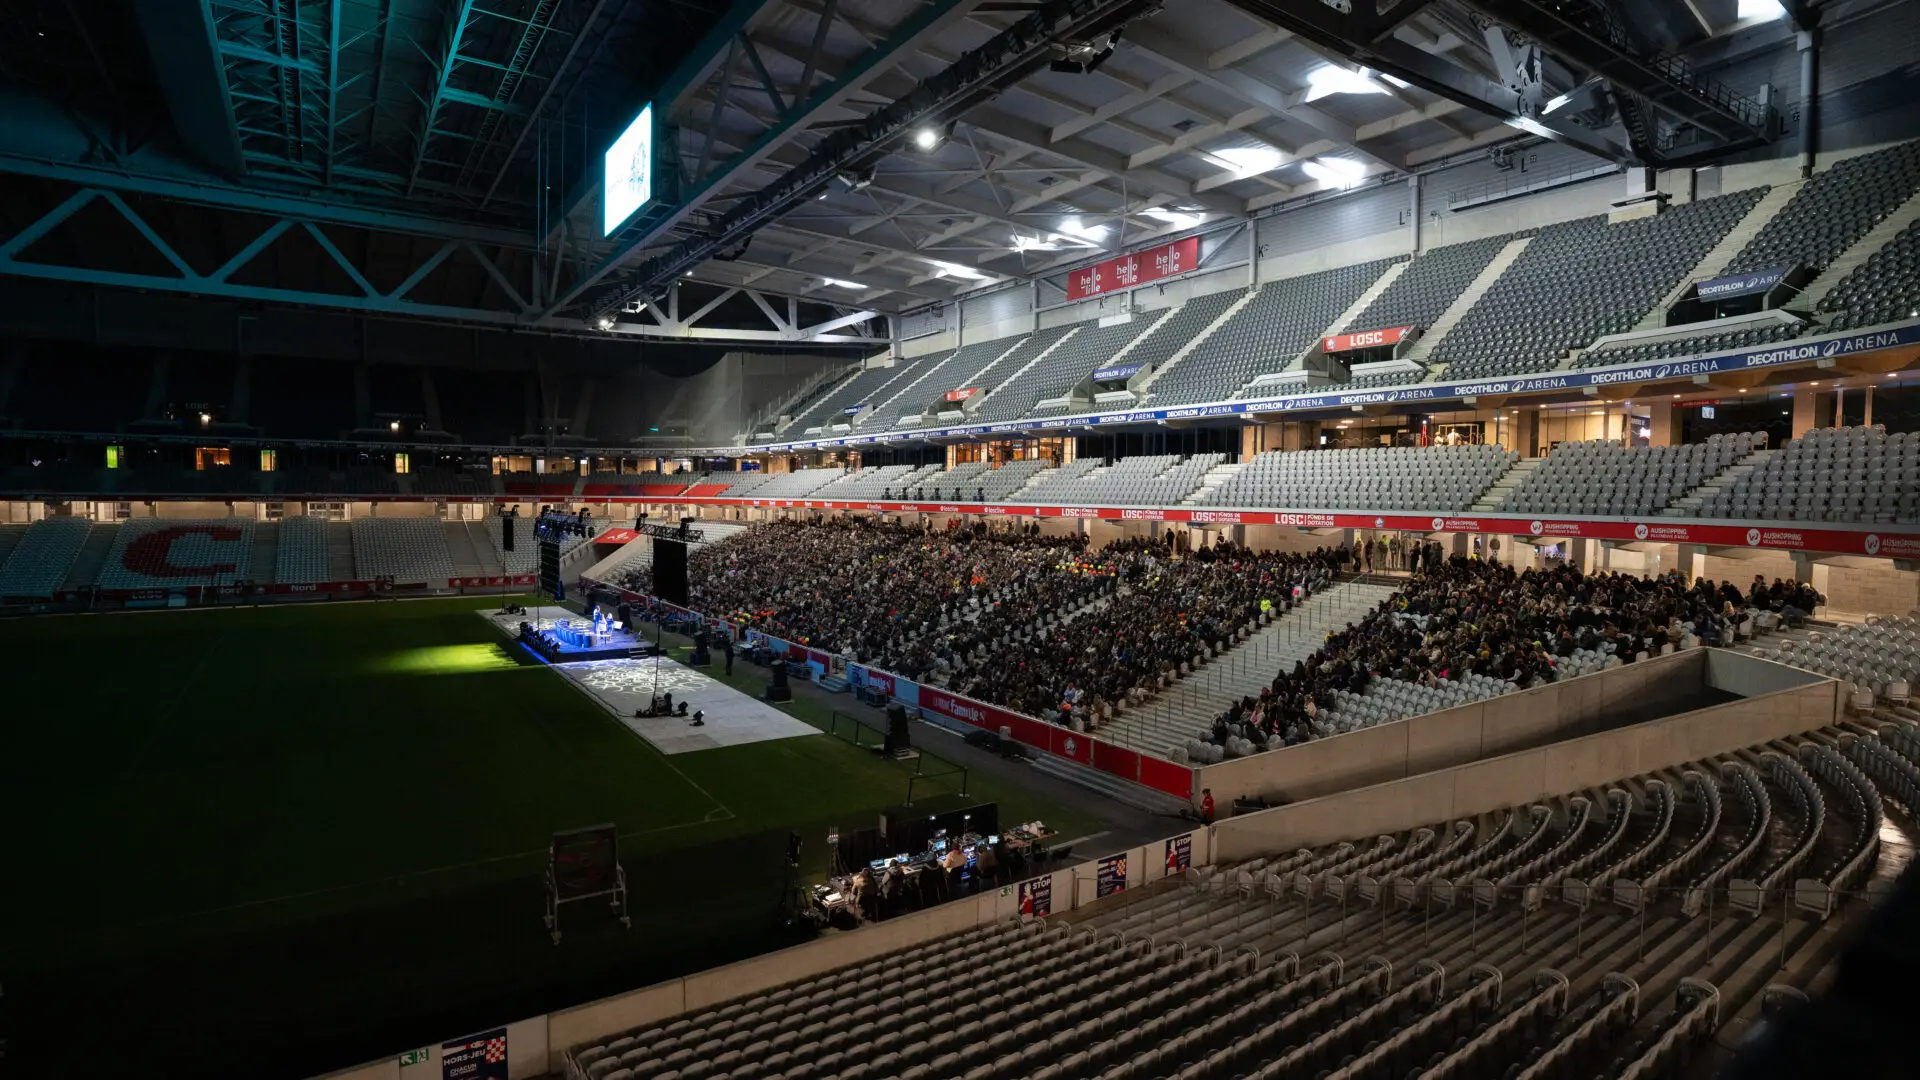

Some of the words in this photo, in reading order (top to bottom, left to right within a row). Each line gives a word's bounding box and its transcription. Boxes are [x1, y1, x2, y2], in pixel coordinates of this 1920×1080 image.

[1698, 282, 1744, 295] DECATHLON
[1350, 331, 1383, 347] LOSC
[1746, 345, 1819, 366] DECATHLON
[1843, 332, 1899, 352] ARENA
[1591, 368, 1652, 384] DECATHLON
[1672, 360, 1719, 375] ARENA
[1455, 383, 1508, 395] DECATHLON
[1526, 378, 1567, 390] ARENA
[1340, 393, 1385, 404] DECATHLON
[1400, 389, 1434, 400] ARENA
[1246, 402, 1283, 412] DECATHLON
[1295, 398, 1324, 407] ARENA
[1099, 414, 1127, 423] DECATHLON
[1135, 412, 1156, 420] ARENA
[1167, 408, 1198, 418] DECATHLON
[1208, 406, 1233, 415] ARENA
[1071, 418, 1090, 426] ARENA
[1061, 508, 1080, 517] LOSC
[1121, 510, 1143, 519] LOSC
[1191, 511, 1216, 522] LOSC
[1275, 514, 1304, 525] LOSC
[1650, 527, 1687, 535] AUSHOPPING
[1763, 531, 1801, 541] AUSHOPPING
[291, 583, 317, 591] Nord
[1032, 878, 1051, 890] STOP
[443, 1048, 487, 1067] HORS-JEU
[450, 1063, 477, 1075] CHACUN
